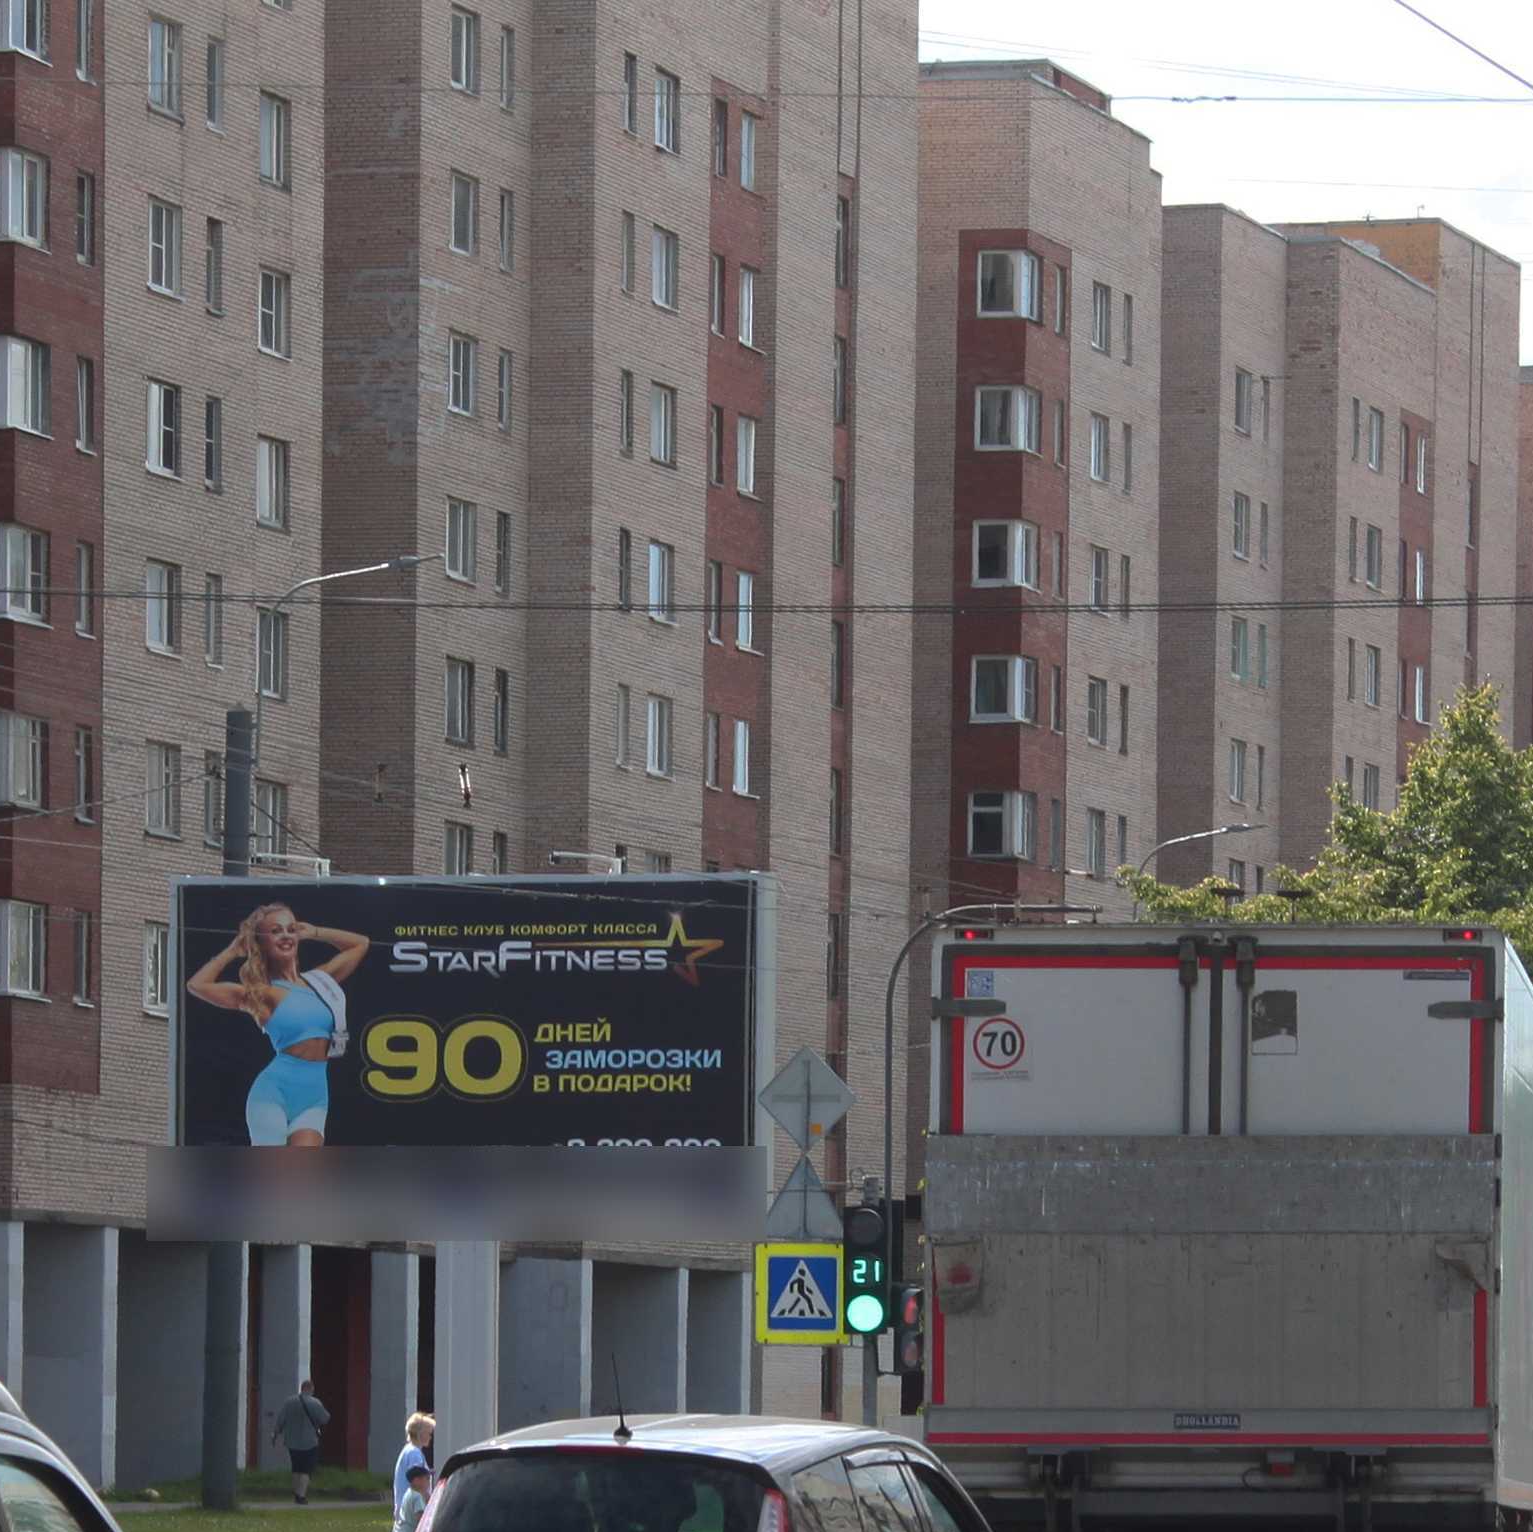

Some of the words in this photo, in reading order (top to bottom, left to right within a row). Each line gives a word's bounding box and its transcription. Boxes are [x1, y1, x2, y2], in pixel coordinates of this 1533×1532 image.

[394, 925, 458, 937] ФИТНЕС
[464, 925, 505, 936] КЛУБ
[510, 924, 588, 936] КОМФОРТ
[593, 923, 658, 935] КЛАССА
[533, 1017, 612, 1043] ДНЕЙ
[981, 1030, 1017, 1057] 70
[366, 1019, 523, 1095] 90
[545, 1048, 722, 1070] ЗАМОРОЗКИ
[533, 1075, 550, 1092] В
[558, 1074, 692, 1093] ПОДАРОК!
[853, 1259, 880, 1284] 21
